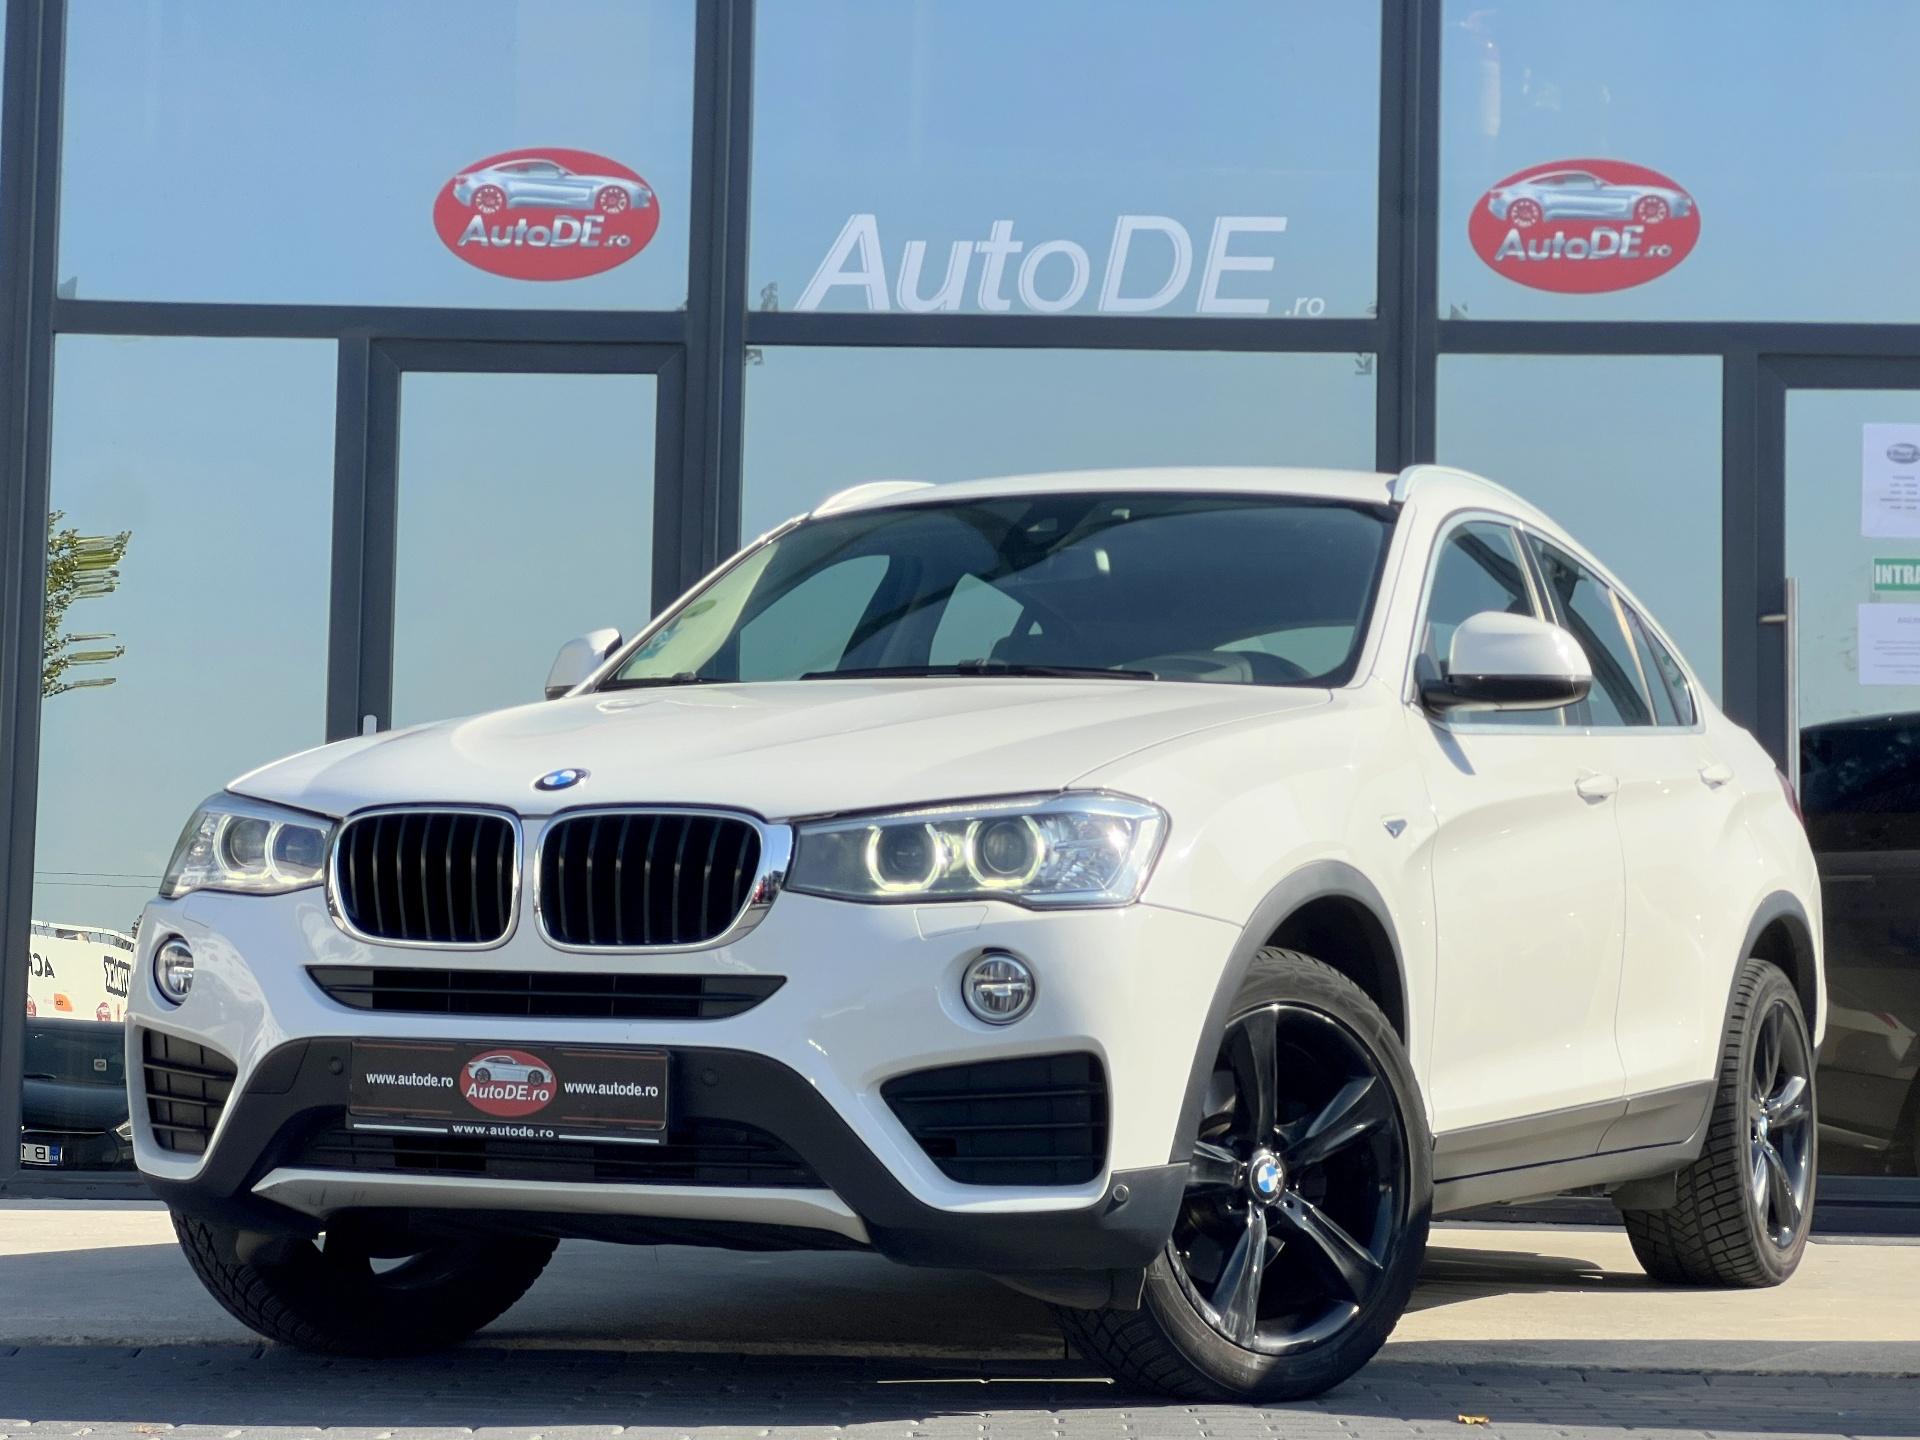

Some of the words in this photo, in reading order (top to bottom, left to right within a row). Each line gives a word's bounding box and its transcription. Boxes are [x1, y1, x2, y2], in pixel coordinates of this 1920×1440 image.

[366, 1072, 454, 1088] www.autode.ro
[466, 1081, 550, 1103] AutoDE.ro
[564, 1080, 659, 1098] www.autode.ro
[452, 1122, 555, 1139] www.autode.ro
